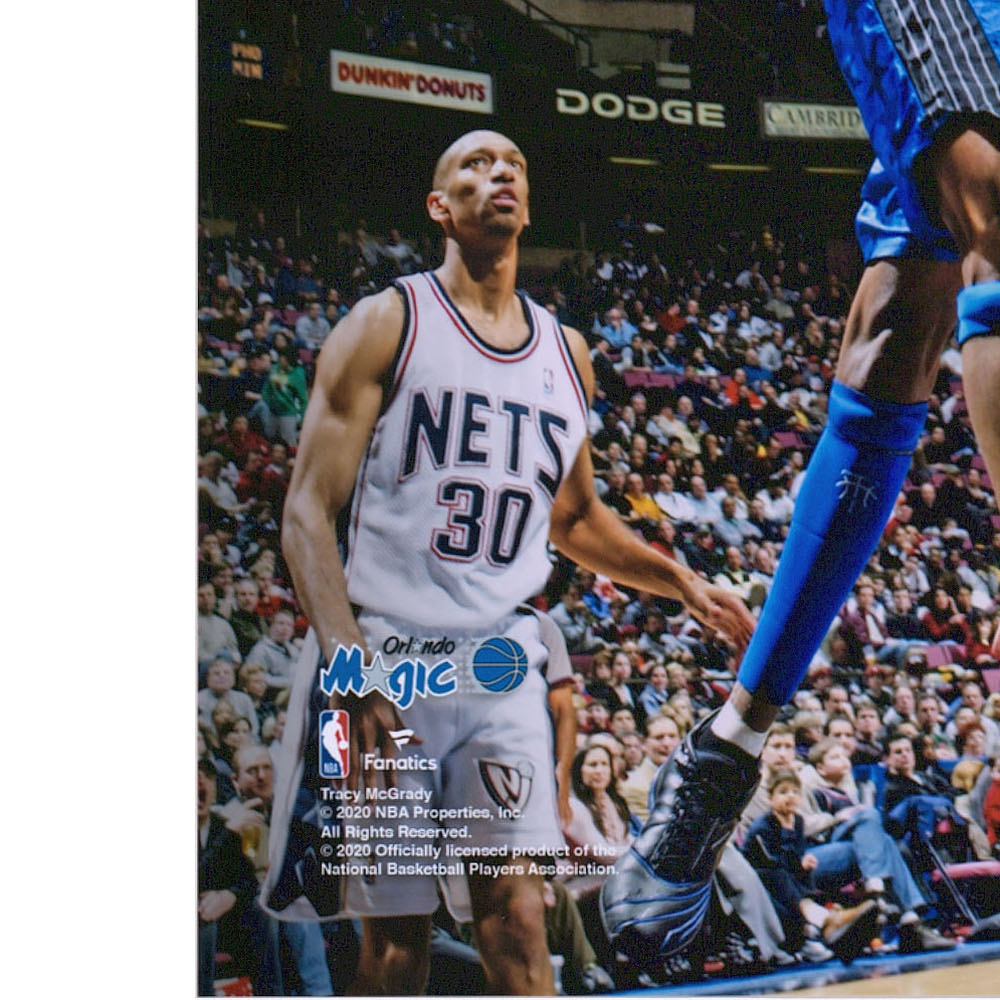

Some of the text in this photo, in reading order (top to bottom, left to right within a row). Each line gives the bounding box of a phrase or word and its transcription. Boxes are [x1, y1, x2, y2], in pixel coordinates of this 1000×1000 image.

[338, 61, 486, 102] DUNKIN' DONUTS
[556, 88, 726, 128] DODGE
[397, 386, 570, 504] NETS
[430, 476, 535, 568] 30
